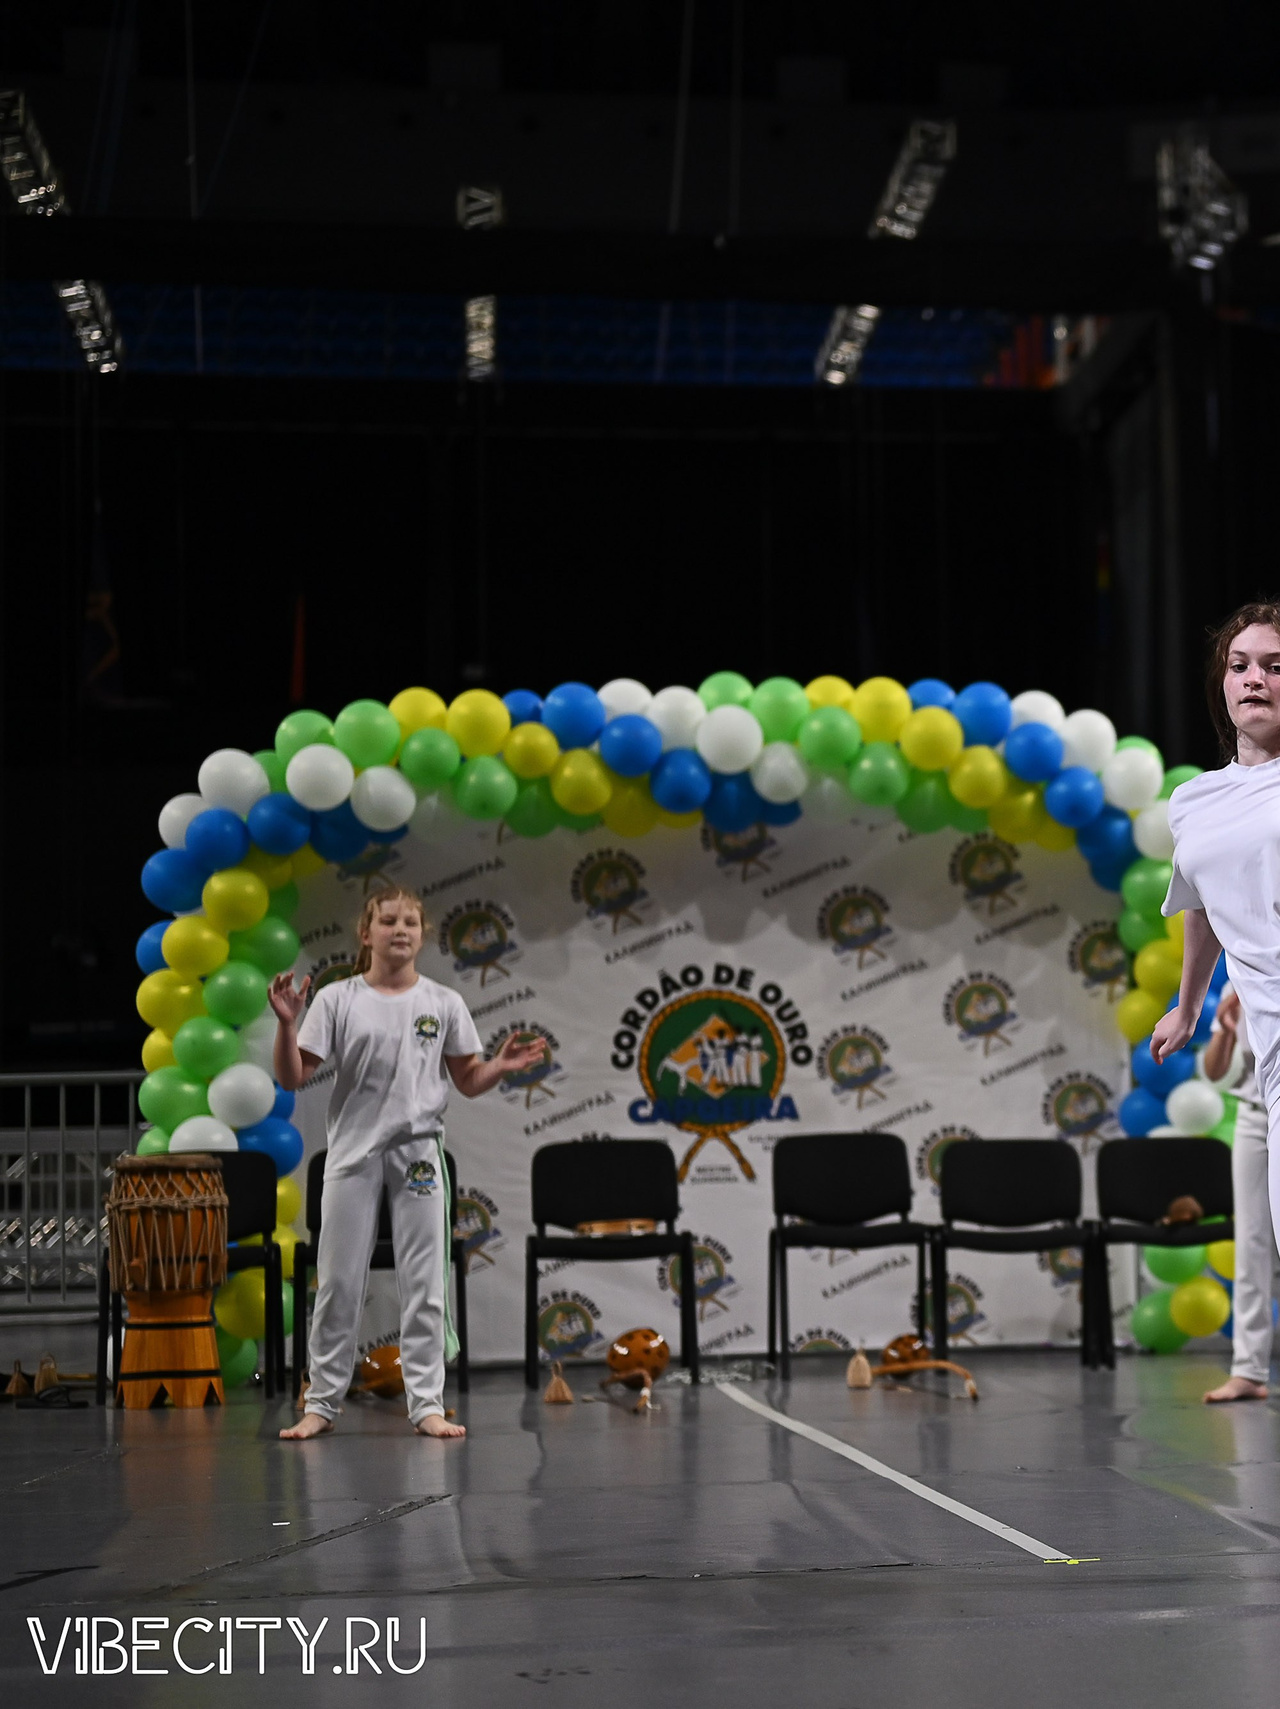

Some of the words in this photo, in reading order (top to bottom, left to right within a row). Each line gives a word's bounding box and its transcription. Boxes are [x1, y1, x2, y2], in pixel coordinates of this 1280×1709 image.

[713, 962, 755, 991] DE
[759, 982, 814, 1067] OURO
[628, 1094, 799, 1125] CAPOEIRA
